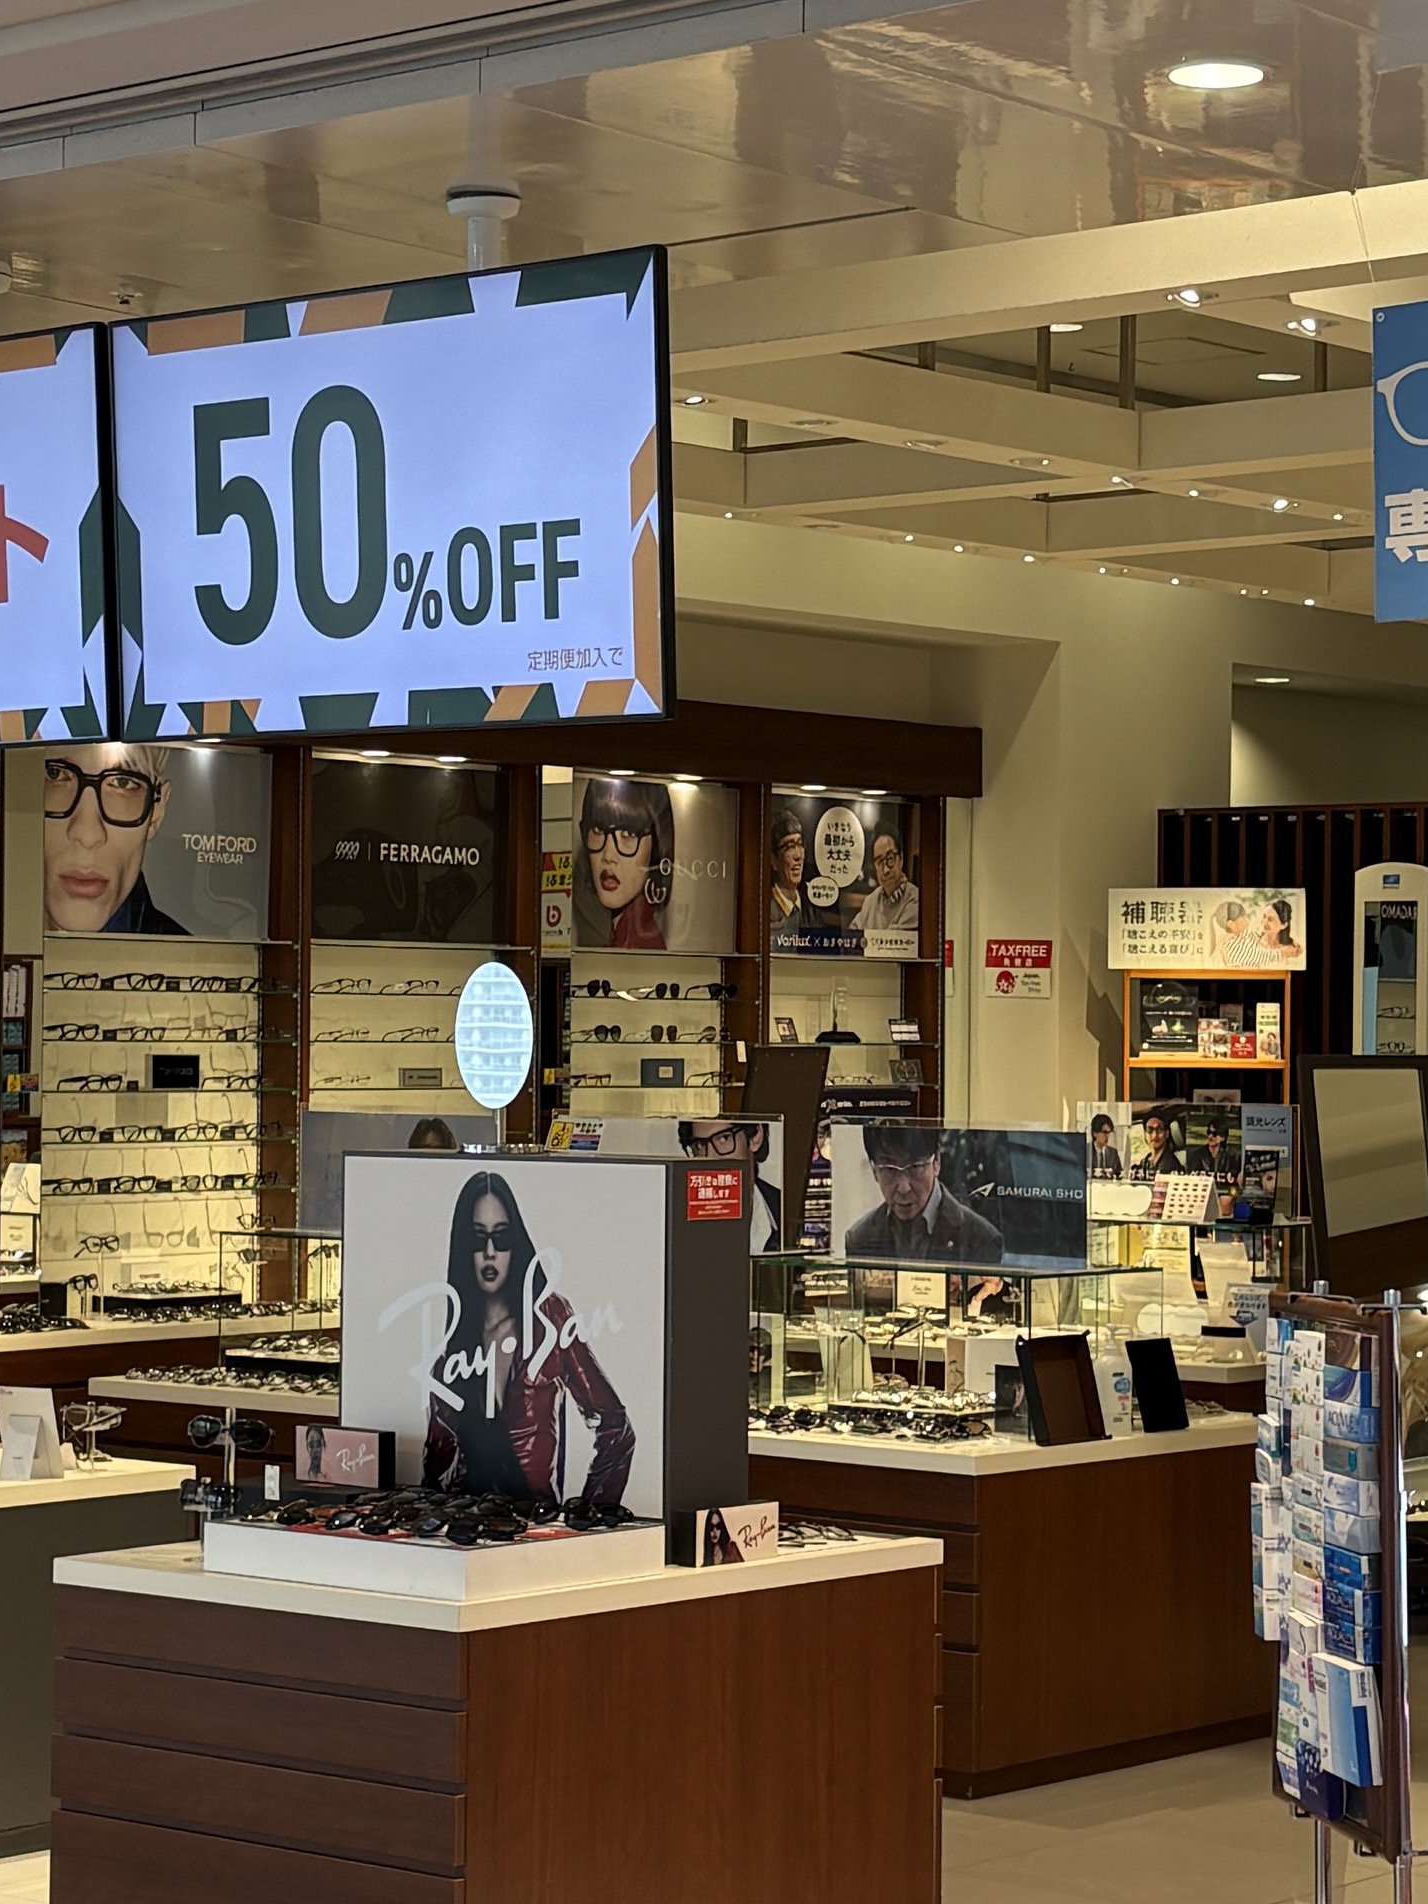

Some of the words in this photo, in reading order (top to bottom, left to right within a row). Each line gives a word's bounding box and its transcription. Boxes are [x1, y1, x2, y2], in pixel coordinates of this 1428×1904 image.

[526, 646, 623, 672] 定期便加入で
[182, 834, 214, 853] TOM
[216, 836, 257, 856] FORD
[197, 851, 244, 865] EYEWEAR
[379, 842, 480, 867] FERRAGAMO
[990, 943, 1048, 957] TAXFREE
[997, 1185, 1052, 1198] SAMURAI
